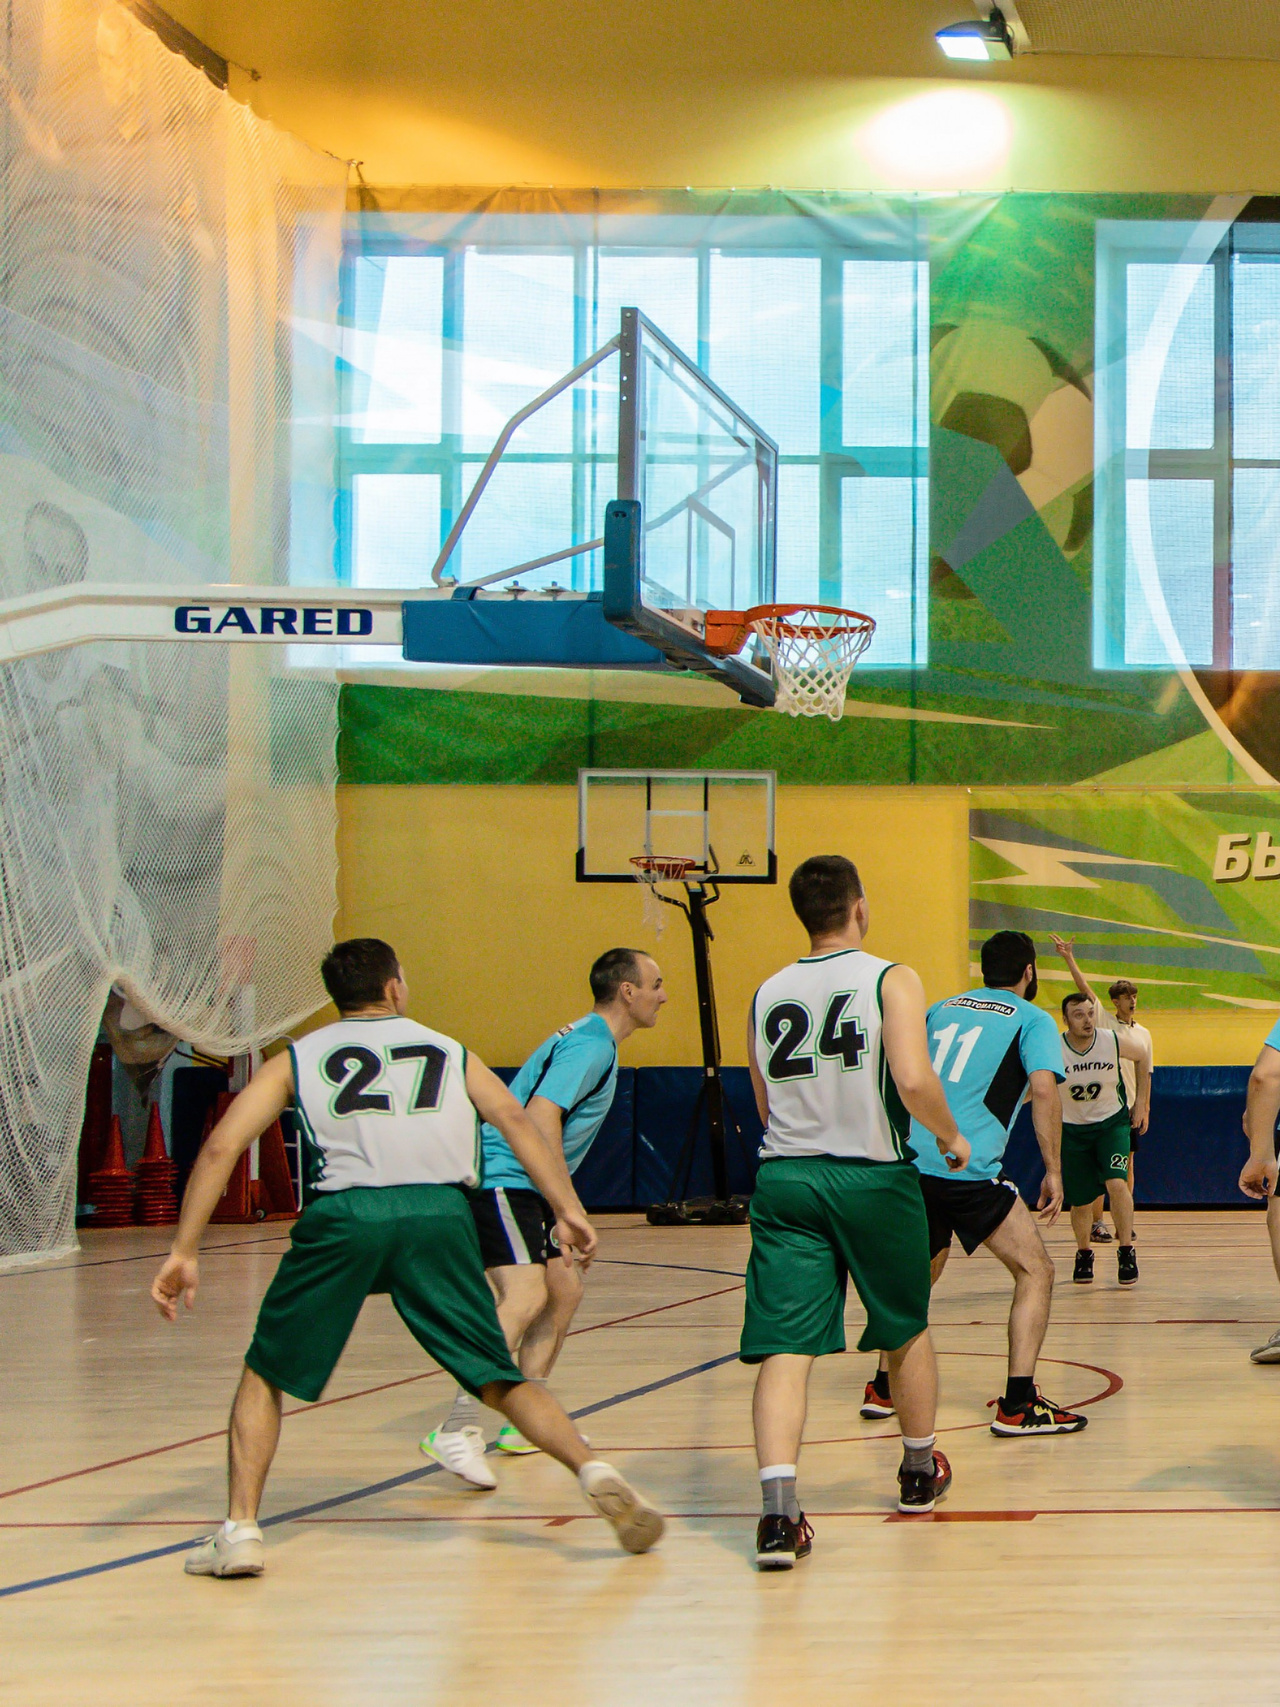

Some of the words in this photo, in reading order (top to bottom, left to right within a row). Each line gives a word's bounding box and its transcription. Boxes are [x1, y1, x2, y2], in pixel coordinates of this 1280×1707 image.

[174, 606, 373, 636] GARED
[763, 990, 869, 1083] 24
[933, 1022, 983, 1083] 11
[320, 1042, 449, 1118] 27
[1073, 1062, 1114, 1073] ЯНГПУР
[1070, 1082, 1102, 1101] 29
